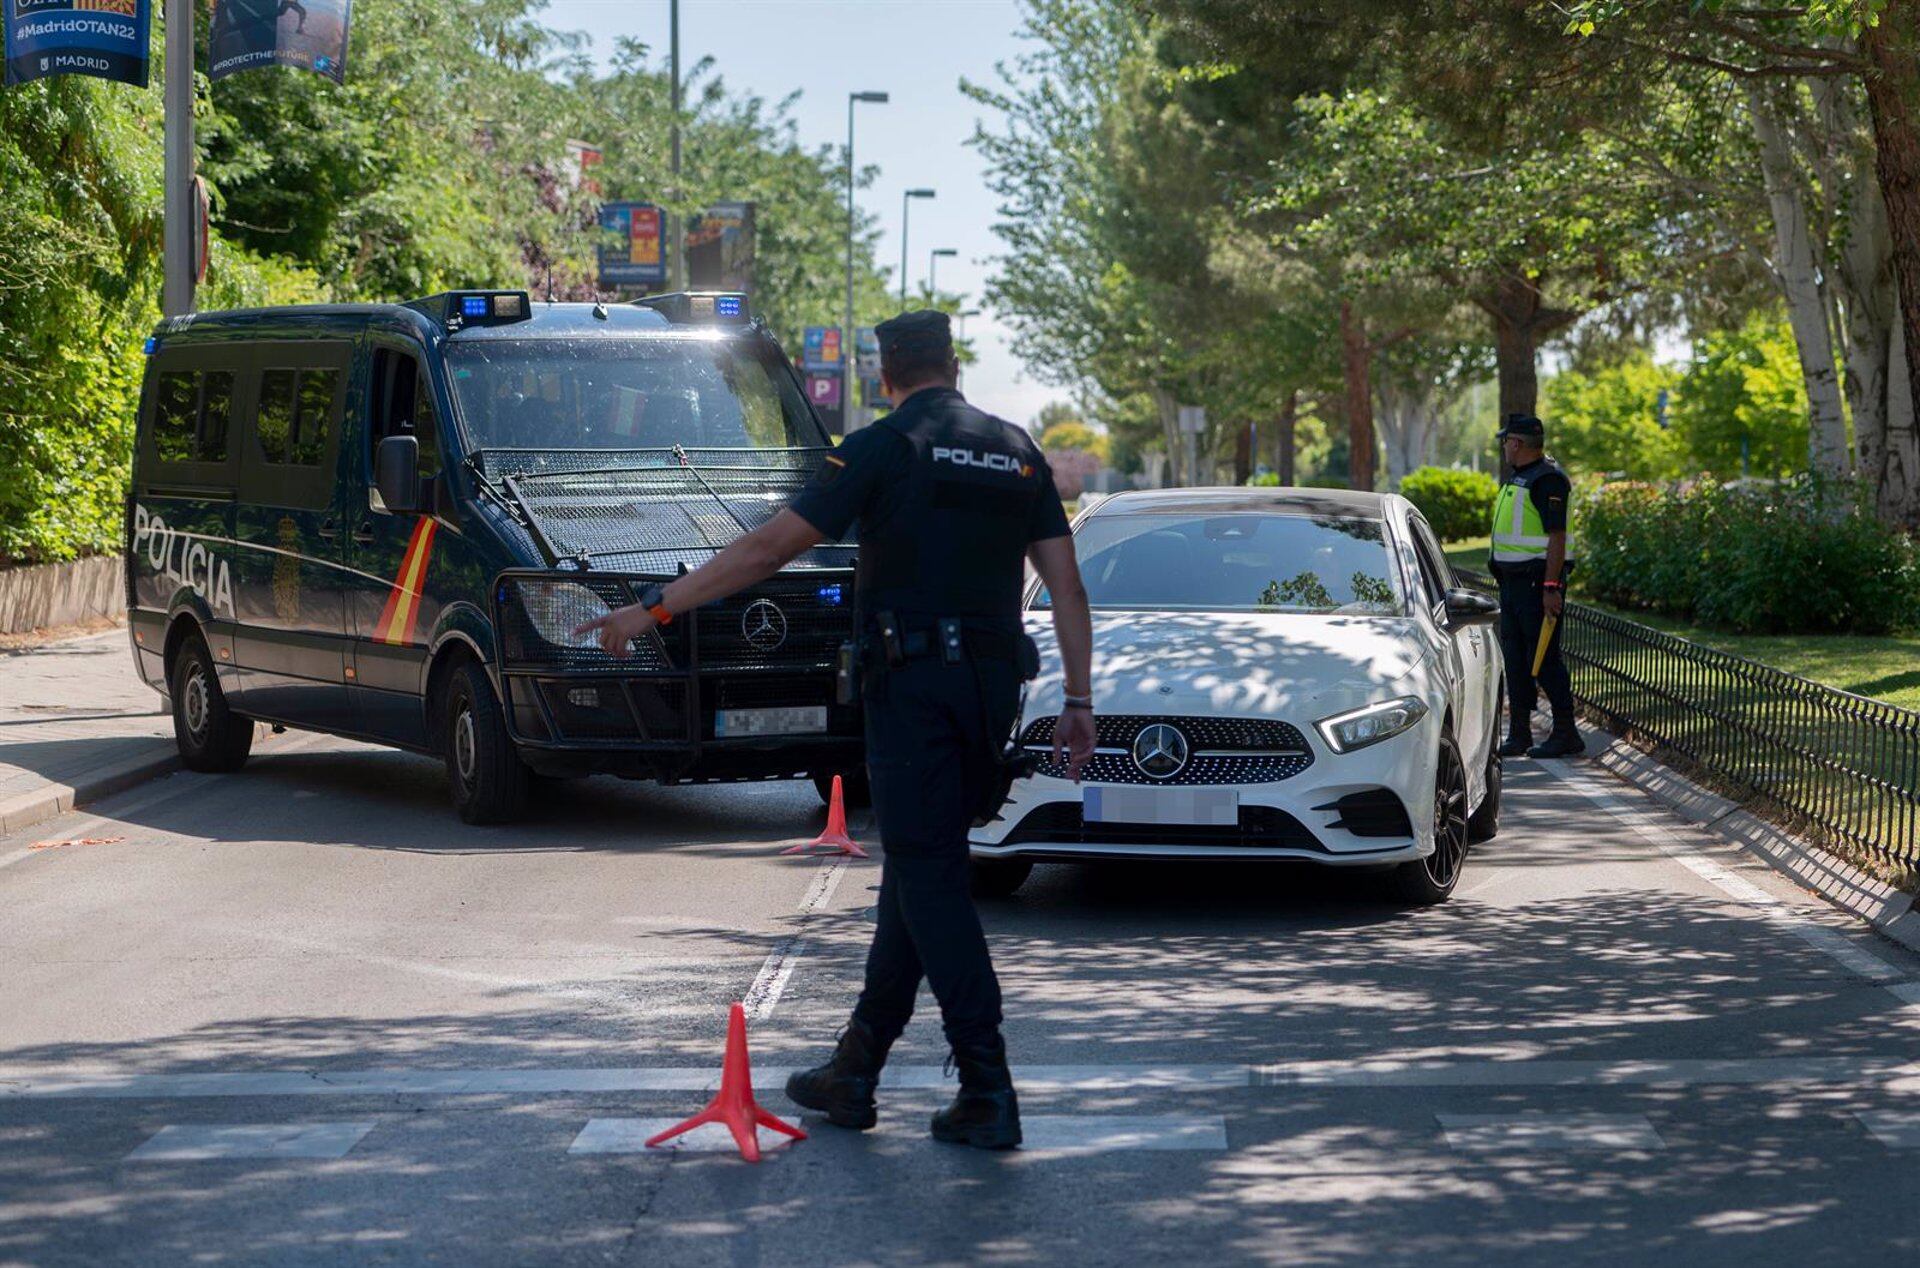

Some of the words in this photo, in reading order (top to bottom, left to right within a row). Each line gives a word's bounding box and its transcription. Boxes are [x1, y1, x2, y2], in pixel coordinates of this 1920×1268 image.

[17, 20, 136, 40] #MadridOTAN22
[55, 55, 110, 71] MADRID
[814, 380, 831, 399] P
[932, 447, 1022, 475] POLICIA
[132, 503, 236, 619] POLICIA
